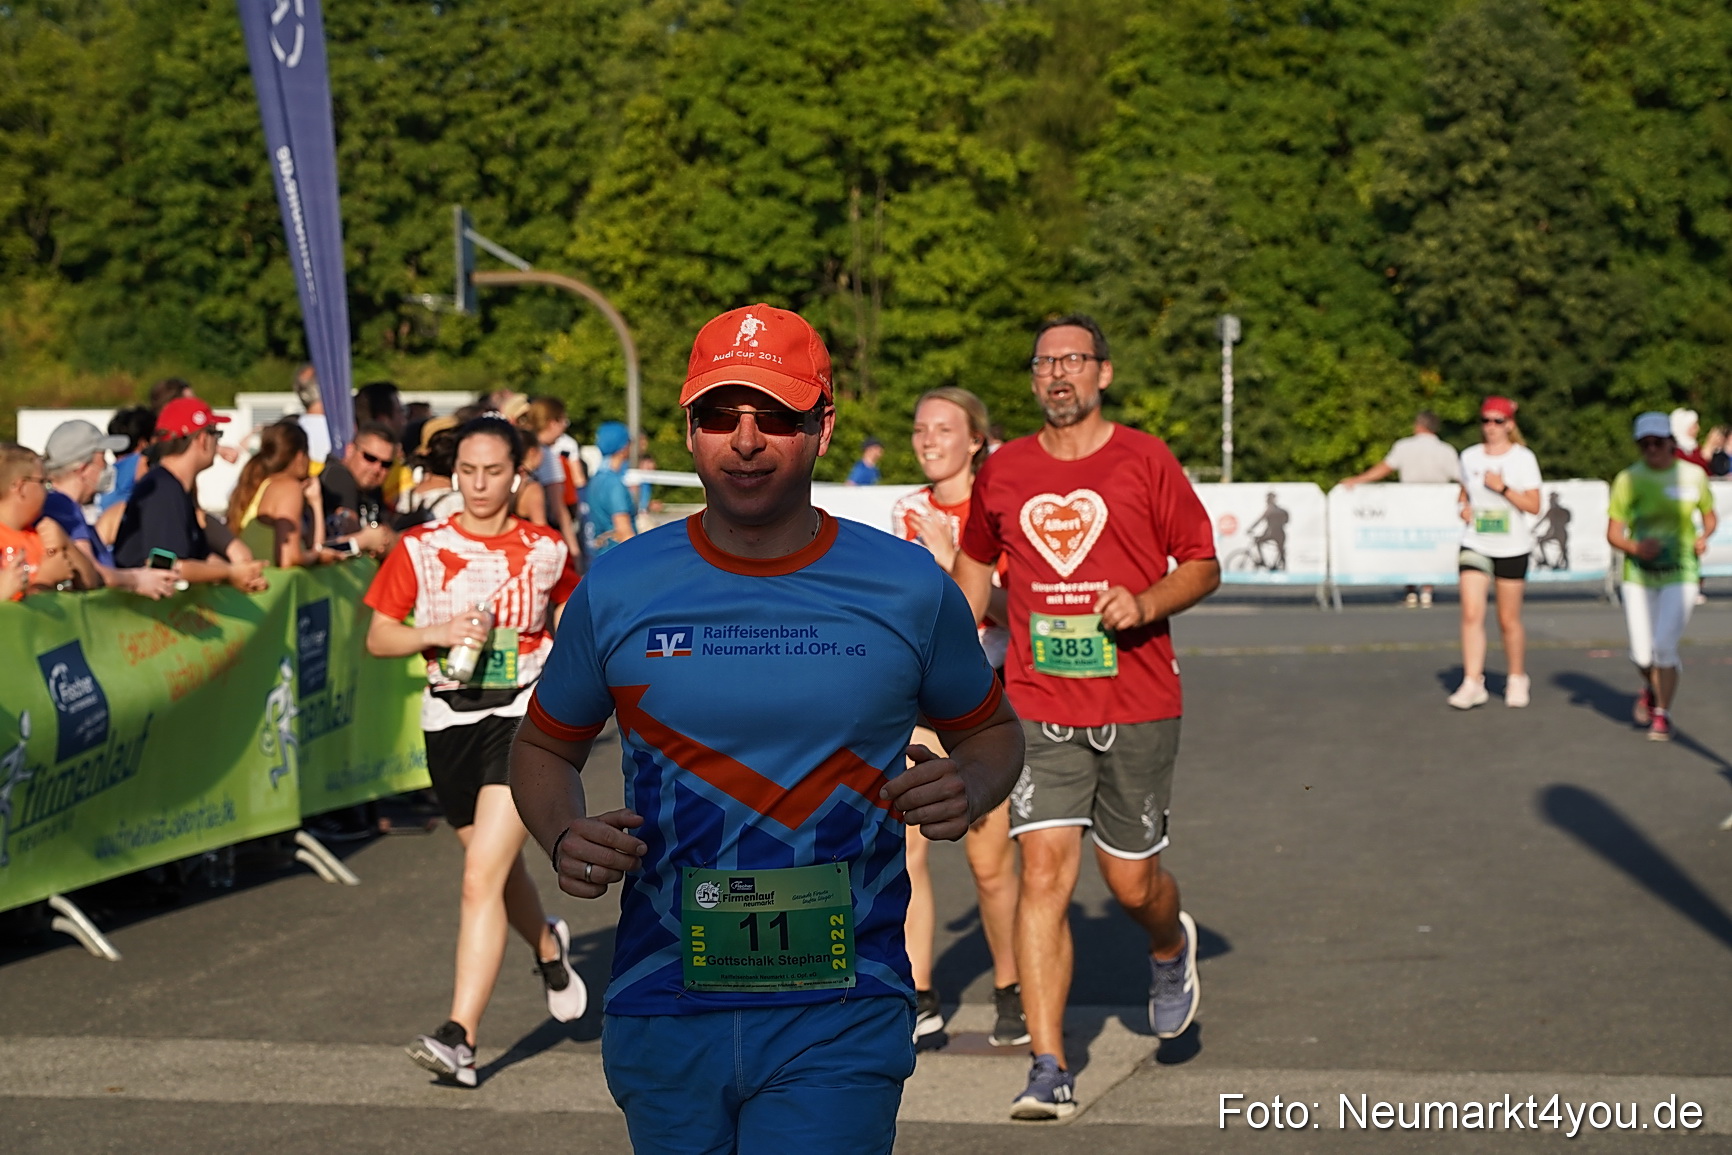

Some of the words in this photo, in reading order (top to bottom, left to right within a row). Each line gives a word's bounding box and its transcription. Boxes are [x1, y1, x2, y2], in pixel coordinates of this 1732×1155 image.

[712, 350, 734, 362] Audi
[758, 352, 783, 364] 2011
[703, 625, 819, 639] Raiffeisenbank
[702, 642, 781, 656] Neumarkt
[845, 644, 866, 657] eG
[1051, 637, 1093, 657] 383
[722, 891, 775, 902] Firmenlauf
[739, 911, 790, 951] 11
[691, 925, 707, 967] RUN
[829, 913, 847, 970] 2022
[706, 954, 774, 967] Gottschalk
[778, 953, 831, 967] Stephan
